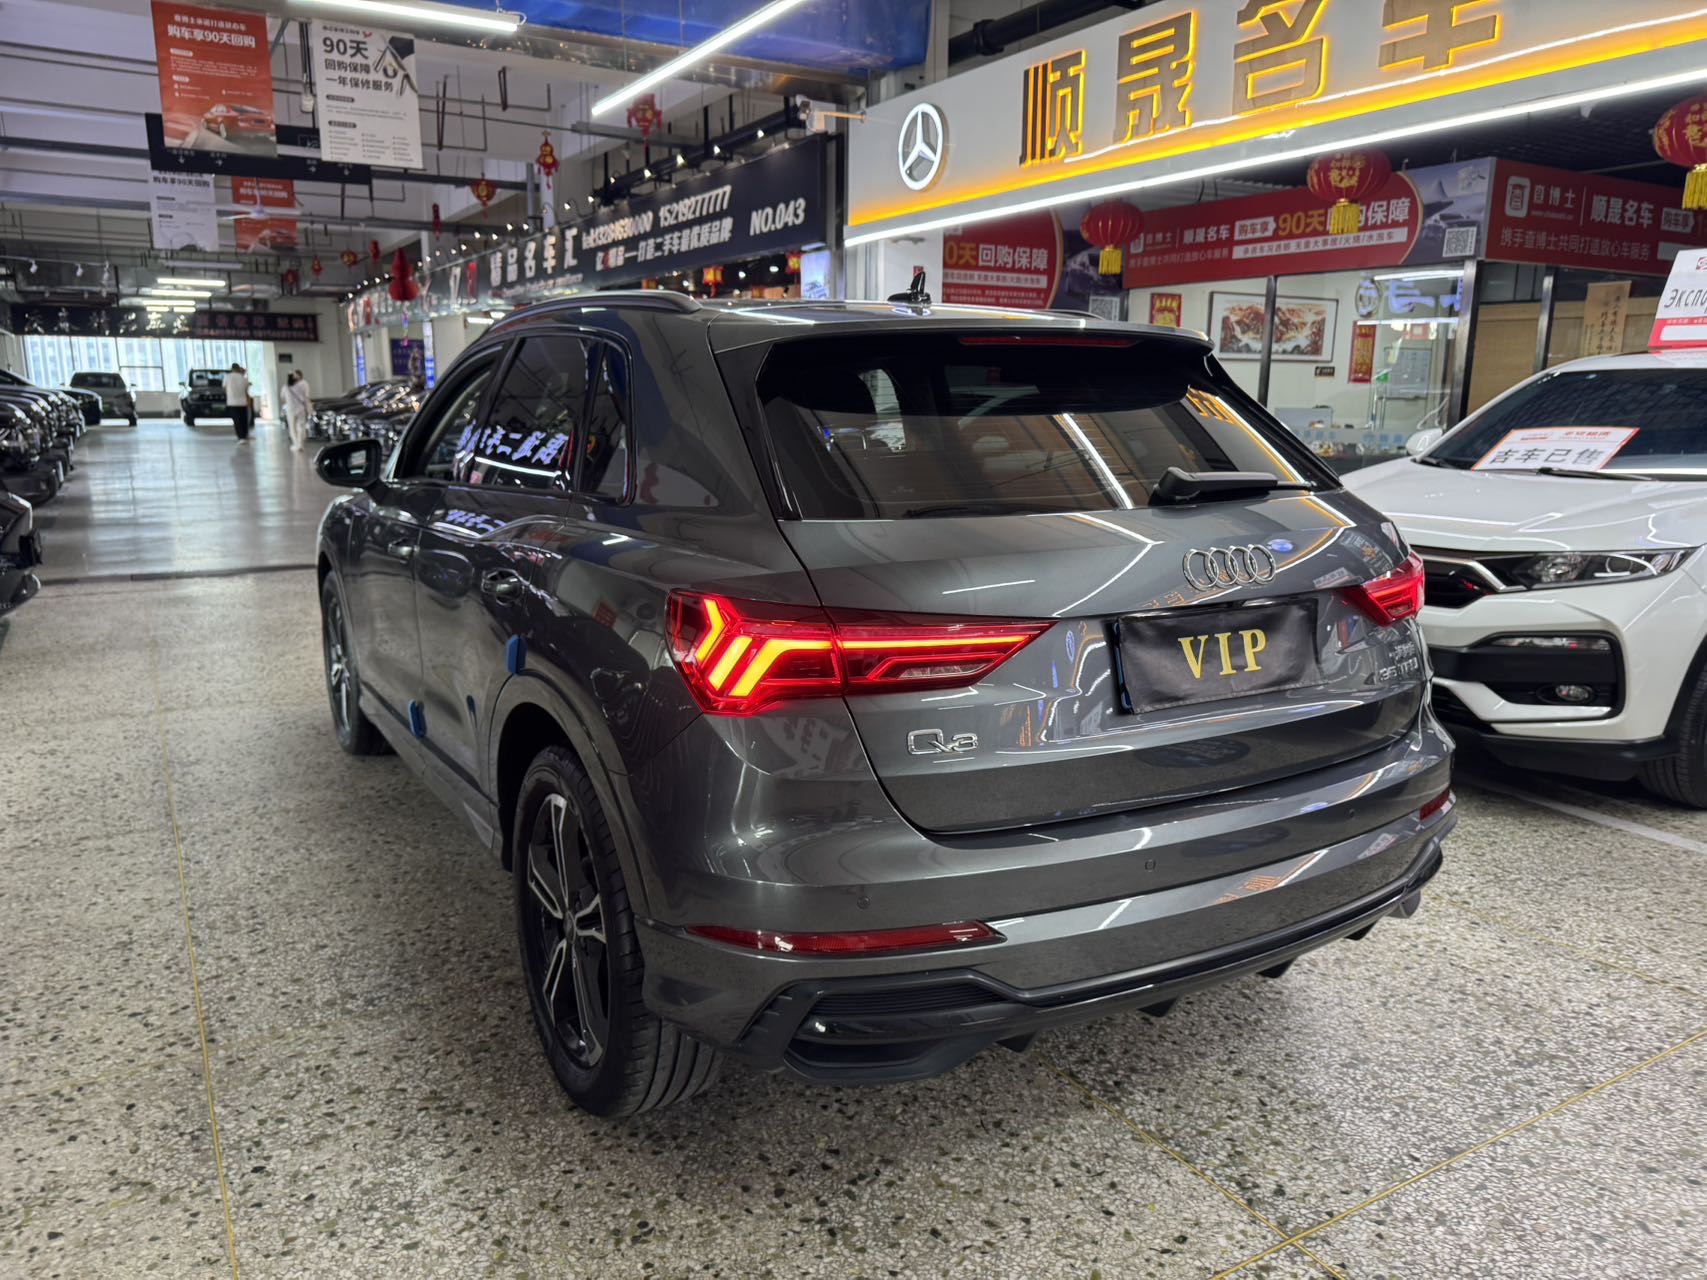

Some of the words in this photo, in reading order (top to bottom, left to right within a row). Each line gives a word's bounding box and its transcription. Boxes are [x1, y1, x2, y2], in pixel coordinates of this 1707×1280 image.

[167, 24, 256, 48] 购车享90天回购
[322, 37, 369, 59] 90天
[325, 58, 371, 75] 回购保障
[325, 75, 394, 93] 一年保修服务
[1019, 0, 1502, 168] 顺晟名车
[749, 197, 806, 236] NO.043
[1177, 628, 1267, 679] VIP
[907, 728, 978, 755] Q3
